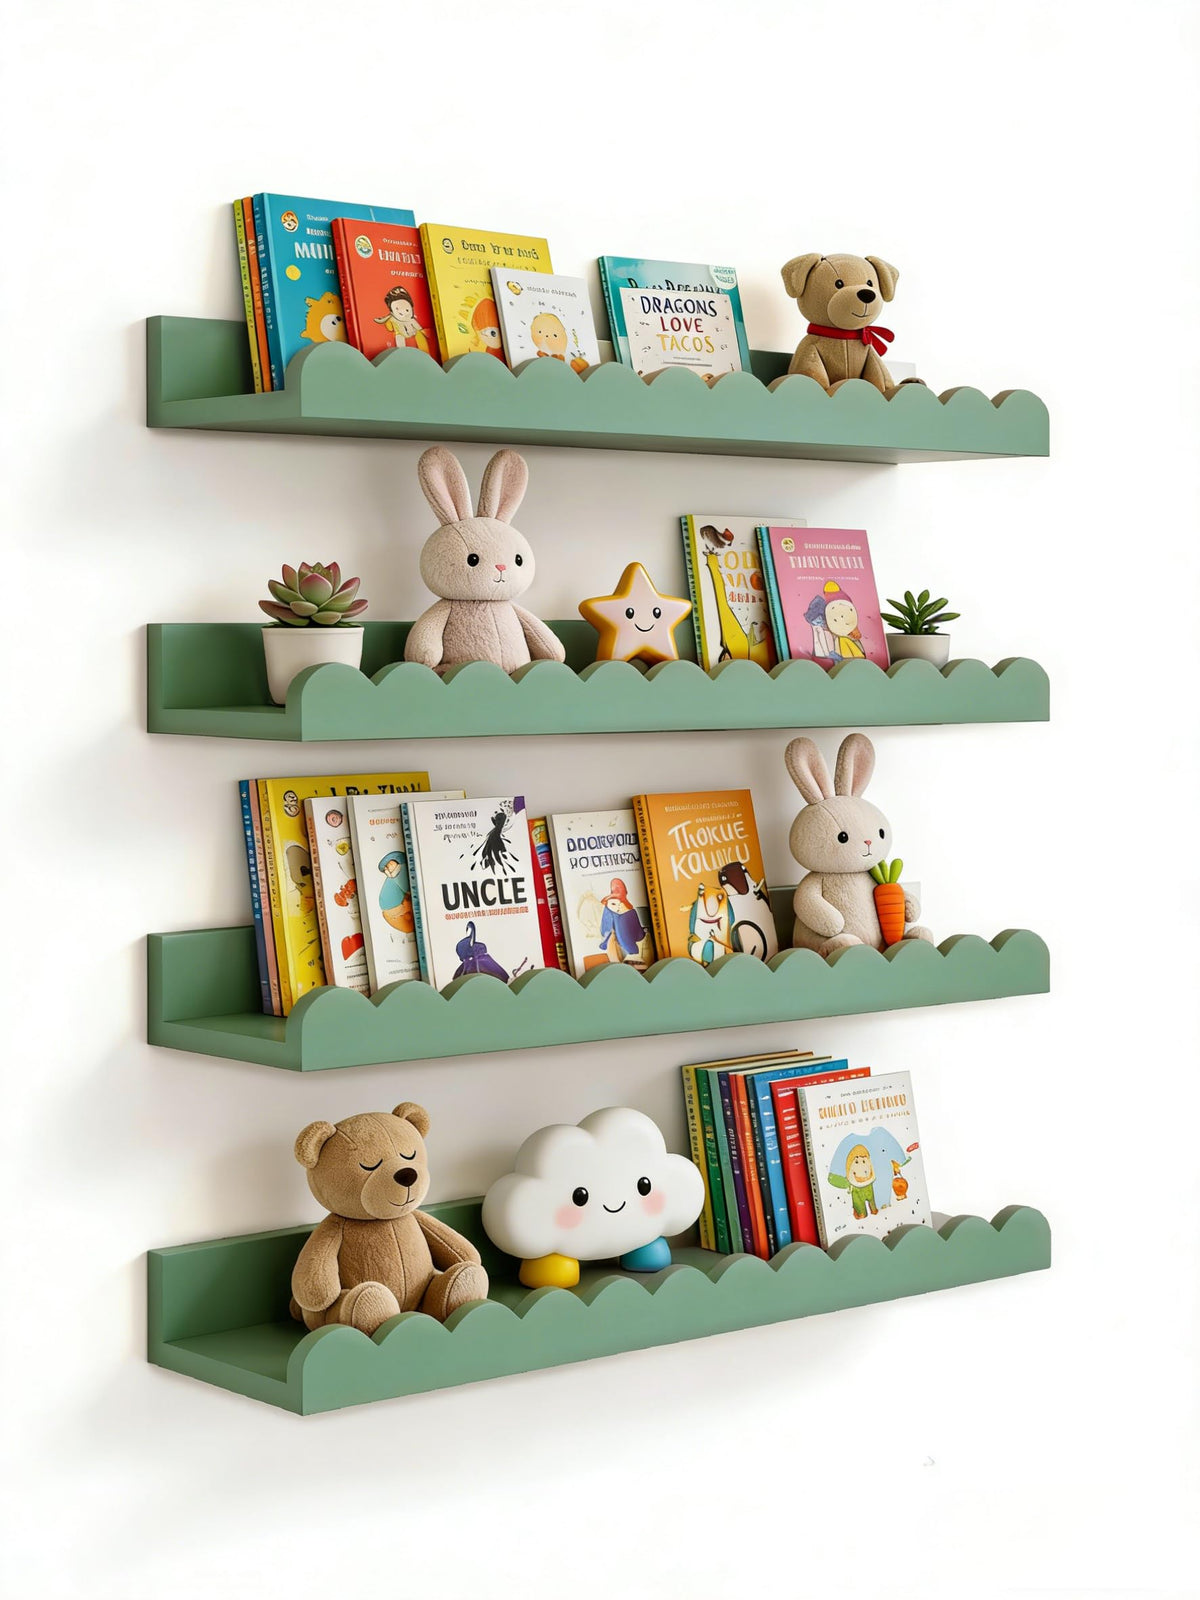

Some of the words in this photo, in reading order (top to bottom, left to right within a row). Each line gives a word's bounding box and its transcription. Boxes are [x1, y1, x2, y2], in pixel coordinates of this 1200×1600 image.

[640, 295, 718, 318] DRAGONS
[660, 315, 704, 333] LOVE
[655, 333, 715, 354] TACOS
[441, 876, 528, 911] UNCLE
